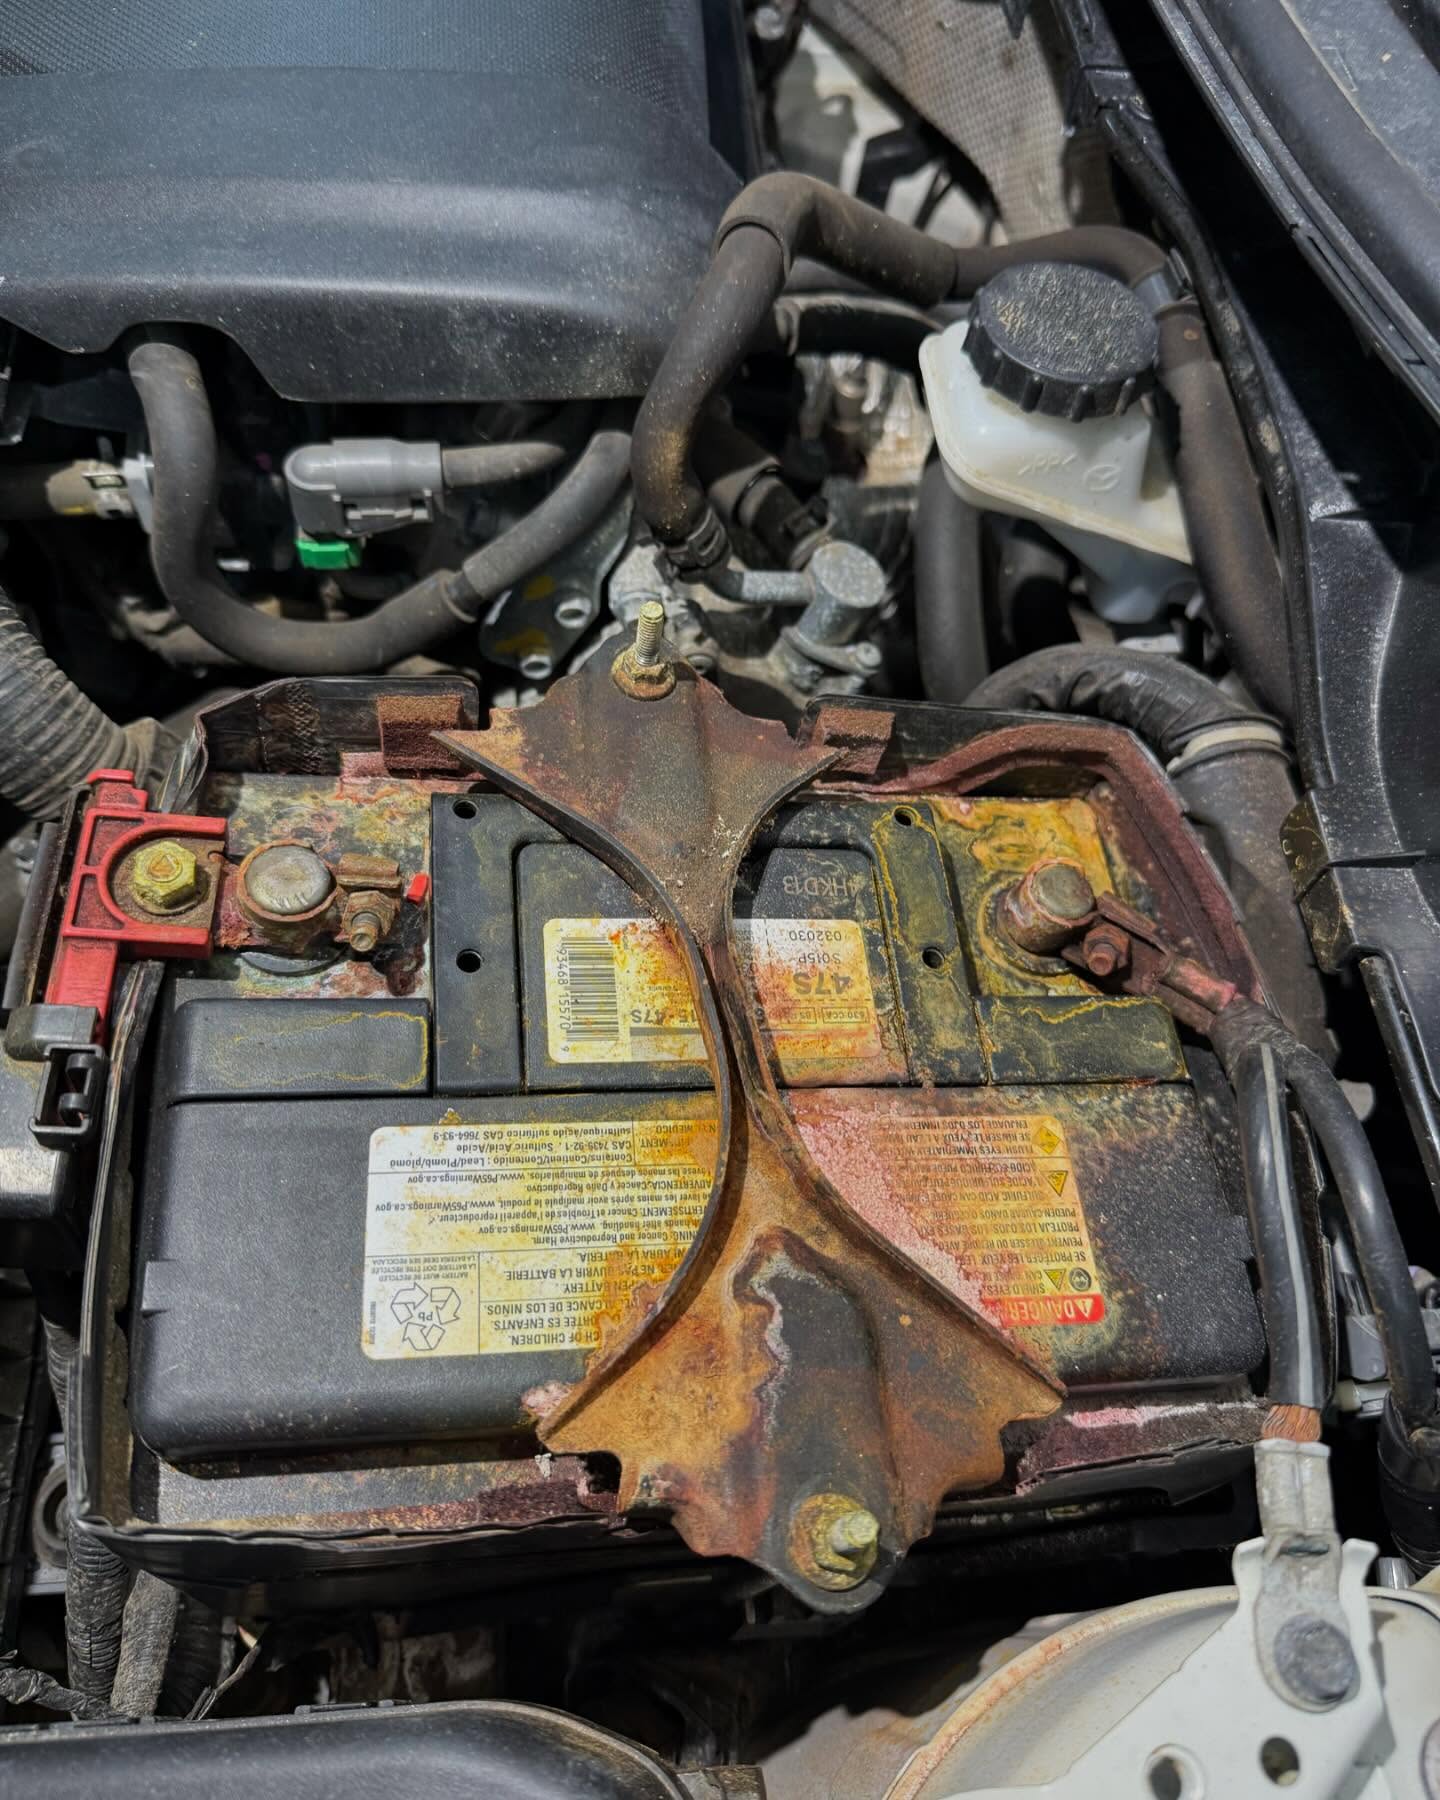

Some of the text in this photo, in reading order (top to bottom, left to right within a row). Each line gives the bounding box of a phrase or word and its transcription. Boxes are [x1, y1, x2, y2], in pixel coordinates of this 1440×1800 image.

[789, 930, 842, 942] 032030
[556, 946, 568, 985] 93468
[792, 972, 853, 995] 47S
[558, 994, 571, 1030] 15570
[967, 1120, 983, 1130] LOS
[432, 1131, 480, 1142] 7664-93-9
[483, 1130, 504, 1141] CAS
[456, 1143, 512, 1154] Acid/Acide
[514, 1142, 553, 1154] Sulfuric
[611, 1140, 632, 1150] CAS
[980, 1144, 1002, 1156] EYES
[492, 1152, 632, 1166] Contains/Contient/Contenido
[588, 1170, 598, 1180] de
[638, 1168, 666, 1176] manos
[668, 1168, 680, 1177] las
[407, 1172, 524, 1184] www.P65Warnings.ca.gov
[586, 1182, 608, 1192] Daño
[610, 1181, 615, 1190] y
[588, 1196, 608, 1205] avoir
[637, 1194, 662, 1204] mains
[665, 1194, 677, 1203] les
[680, 1194, 700, 1202] laver
[978, 1190, 999, 1202] ACID
[375, 1200, 495, 1212] www.P65Warnings.ca.gov
[534, 1199, 542, 1208] le
[437, 1210, 498, 1224] reproducteur.
[500, 1209, 543, 1222] l'appareil
[545, 1210, 555, 1220] de
[557, 1208, 596, 1218] Troubles
[596, 1208, 605, 1217] et
[607, 1208, 638, 1217] Cancer
[1044, 1206, 1076, 1218] PUEDEN
[478, 1222, 595, 1234] www.P65Warnings.ca.gov
[600, 1218, 639, 1231] handling.
[642, 1220, 662, 1230] after
[665, 1218, 690, 1230] hands
[1039, 1221, 1079, 1233] PROTEJA
[532, 1236, 557, 1246] Harm.
[559, 1232, 616, 1246] Reproductive
[620, 1234, 634, 1244] and
[638, 1232, 668, 1242] Cancer
[1074, 1250, 1086, 1262] SE
[438, 1264, 466, 1272] BATTERIE
[559, 1268, 572, 1278] LA
[378, 1274, 412, 1282] RECYCLED
[441, 1272, 468, 1280] BATTERY
[503, 1269, 556, 1281] BATTERIE.
[484, 1303, 522, 1317] NIÑOS.
[526, 1302, 546, 1314] LOS
[548, 1302, 563, 1312] DE
[1008, 1299, 1076, 1320] DANGER
[418, 1311, 434, 1321] Pb
[490, 1318, 544, 1330] ENFANTS.
[508, 1332, 566, 1346] CHILDREN.
[568, 1332, 582, 1343] OF
